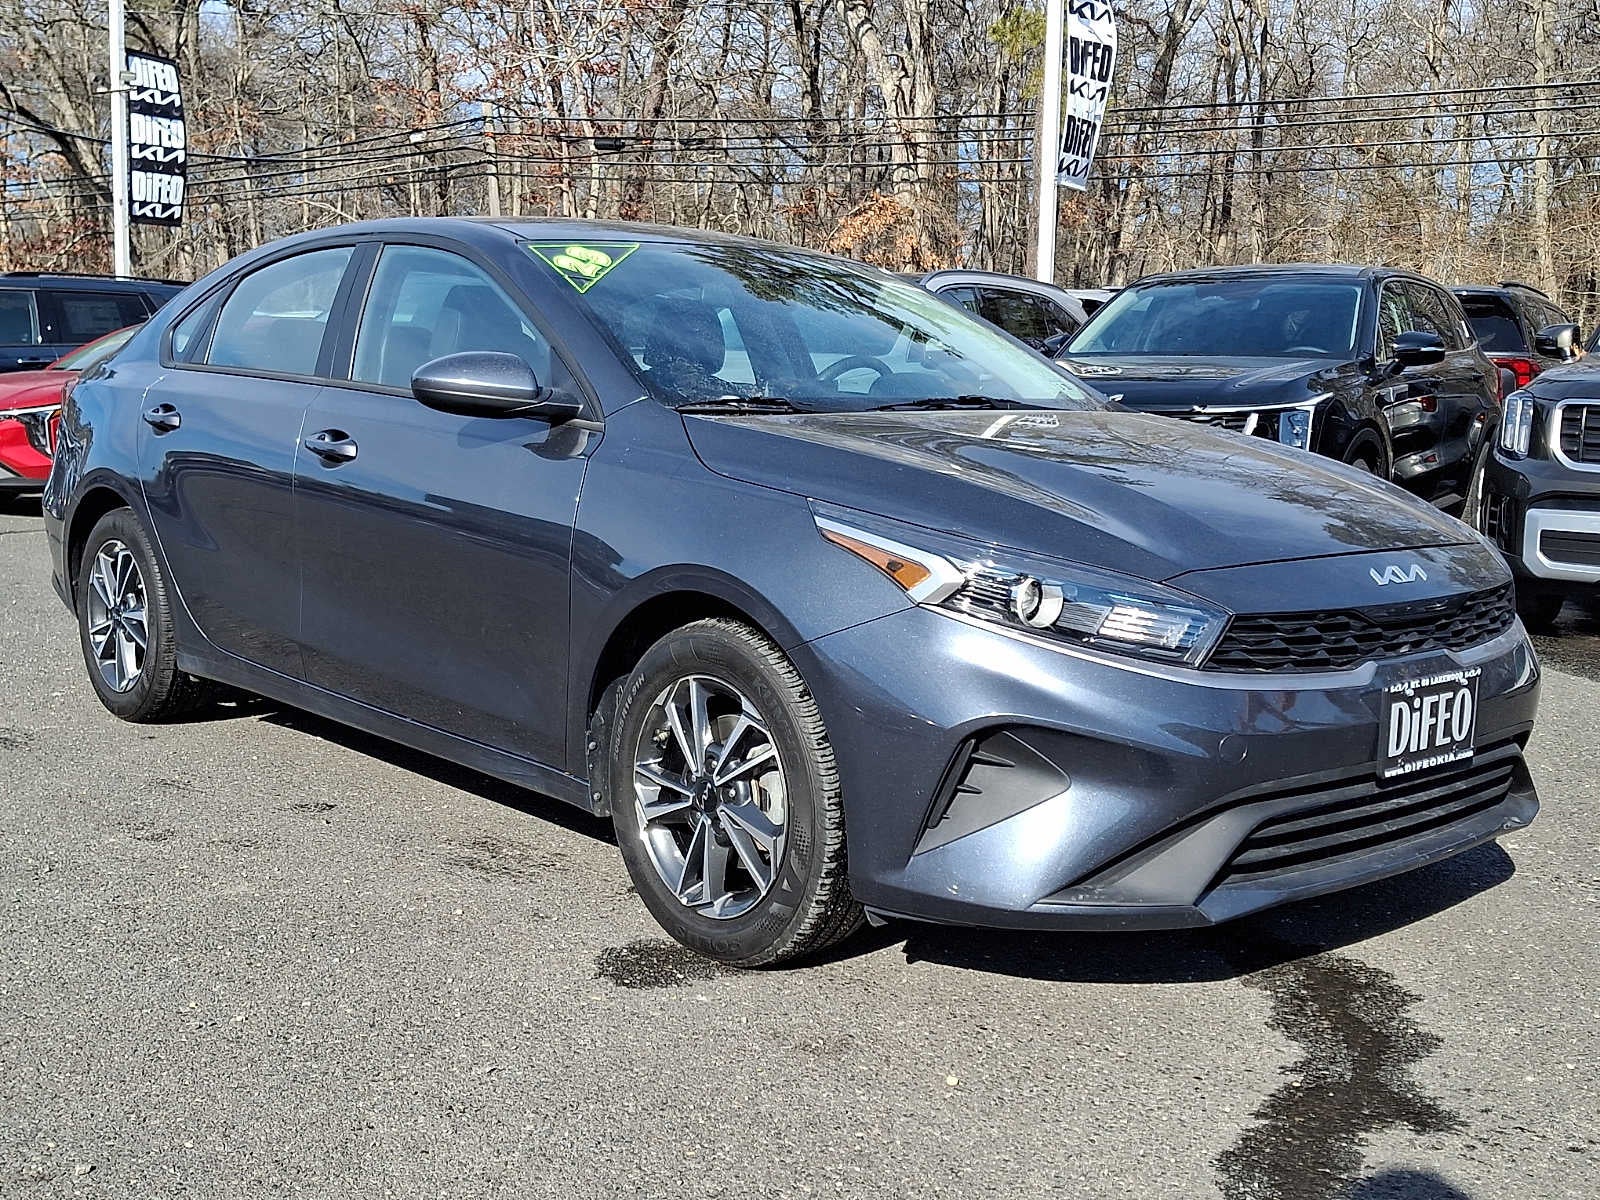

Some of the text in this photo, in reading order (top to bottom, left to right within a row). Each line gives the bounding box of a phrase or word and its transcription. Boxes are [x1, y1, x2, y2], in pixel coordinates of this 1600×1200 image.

[1070, 35, 1113, 83] DiFEO
[130, 112, 185, 149] DiFEO
[131, 144, 186, 164] KIA
[131, 170, 185, 205] DiFEO
[132, 201, 182, 219] KIA
[1369, 564, 1428, 586] KIA
[1388, 688, 1473, 758] DiFEO
